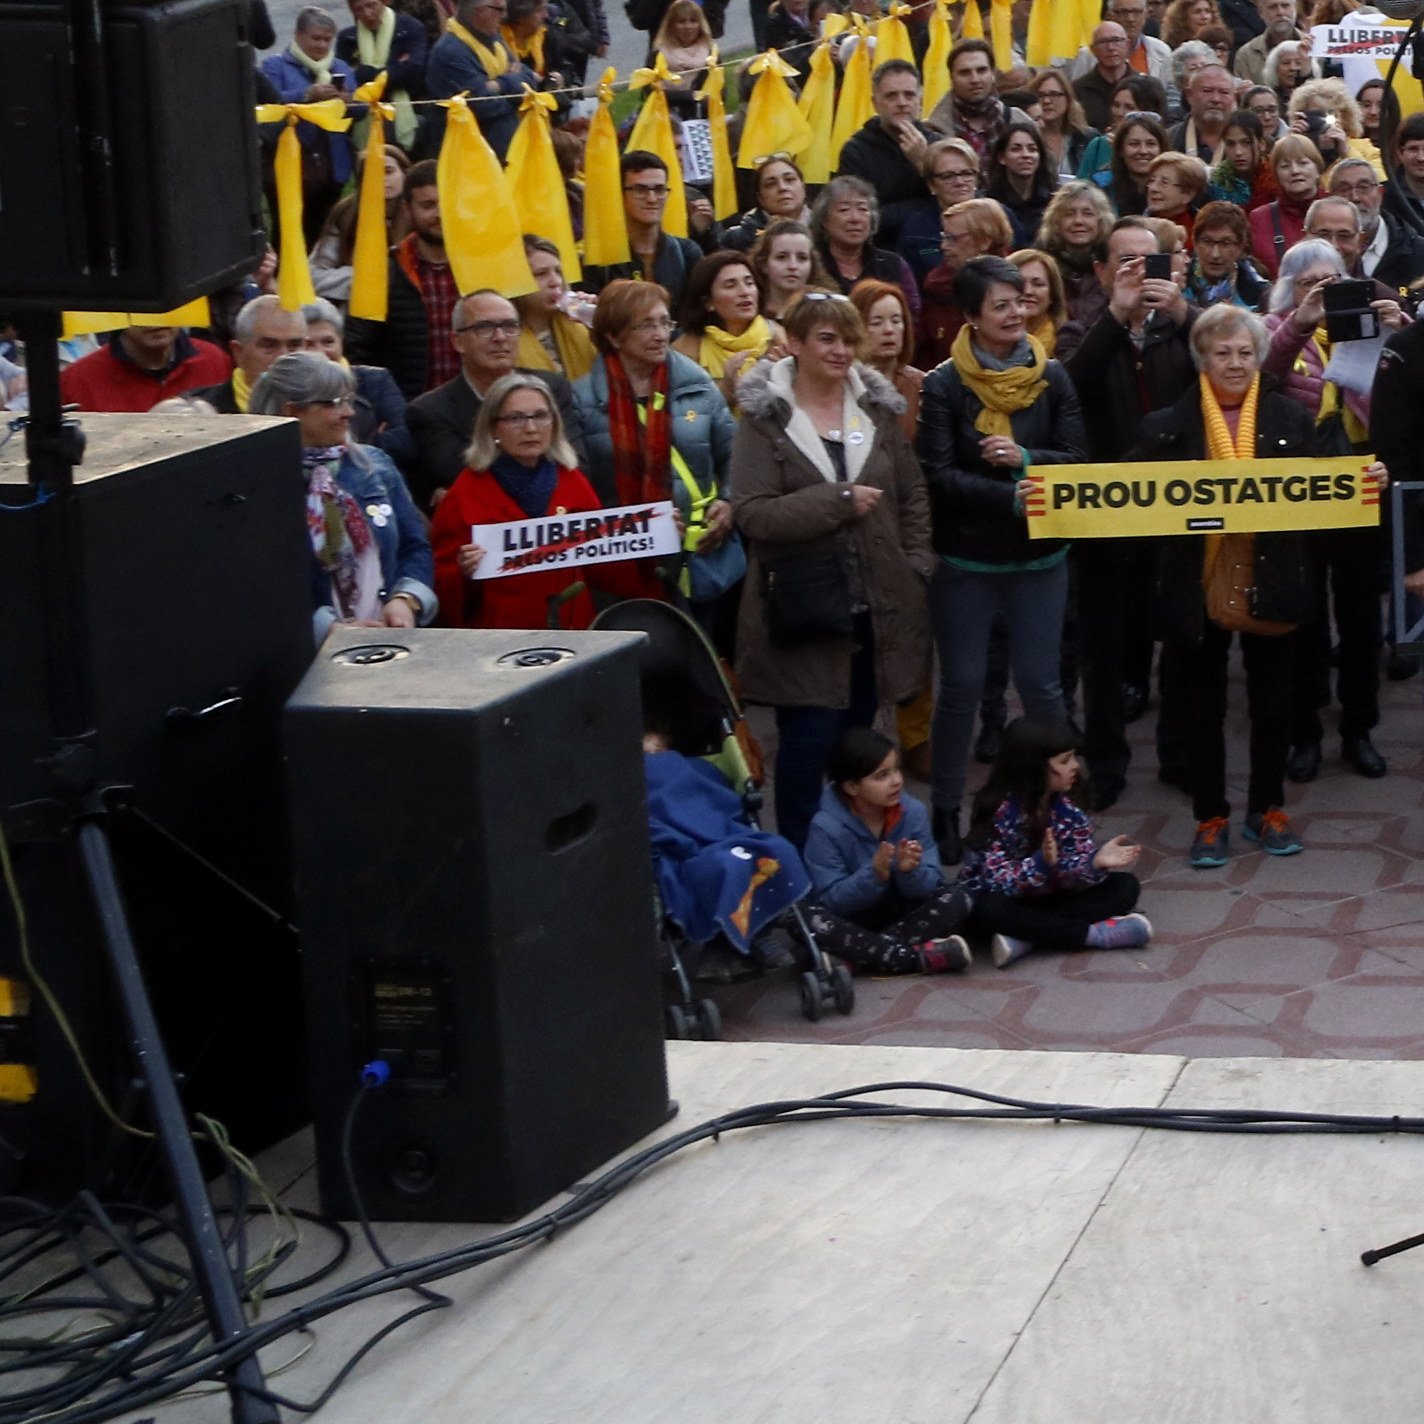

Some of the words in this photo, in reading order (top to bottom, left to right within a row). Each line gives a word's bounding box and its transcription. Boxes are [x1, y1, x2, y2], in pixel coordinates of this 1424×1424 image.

[1052, 479, 1156, 510] PROU
[1164, 473, 1356, 507] OSTATGES
[503, 509, 653, 552] LLIBERTAT
[574, 537, 655, 560] POLÍTICS!
